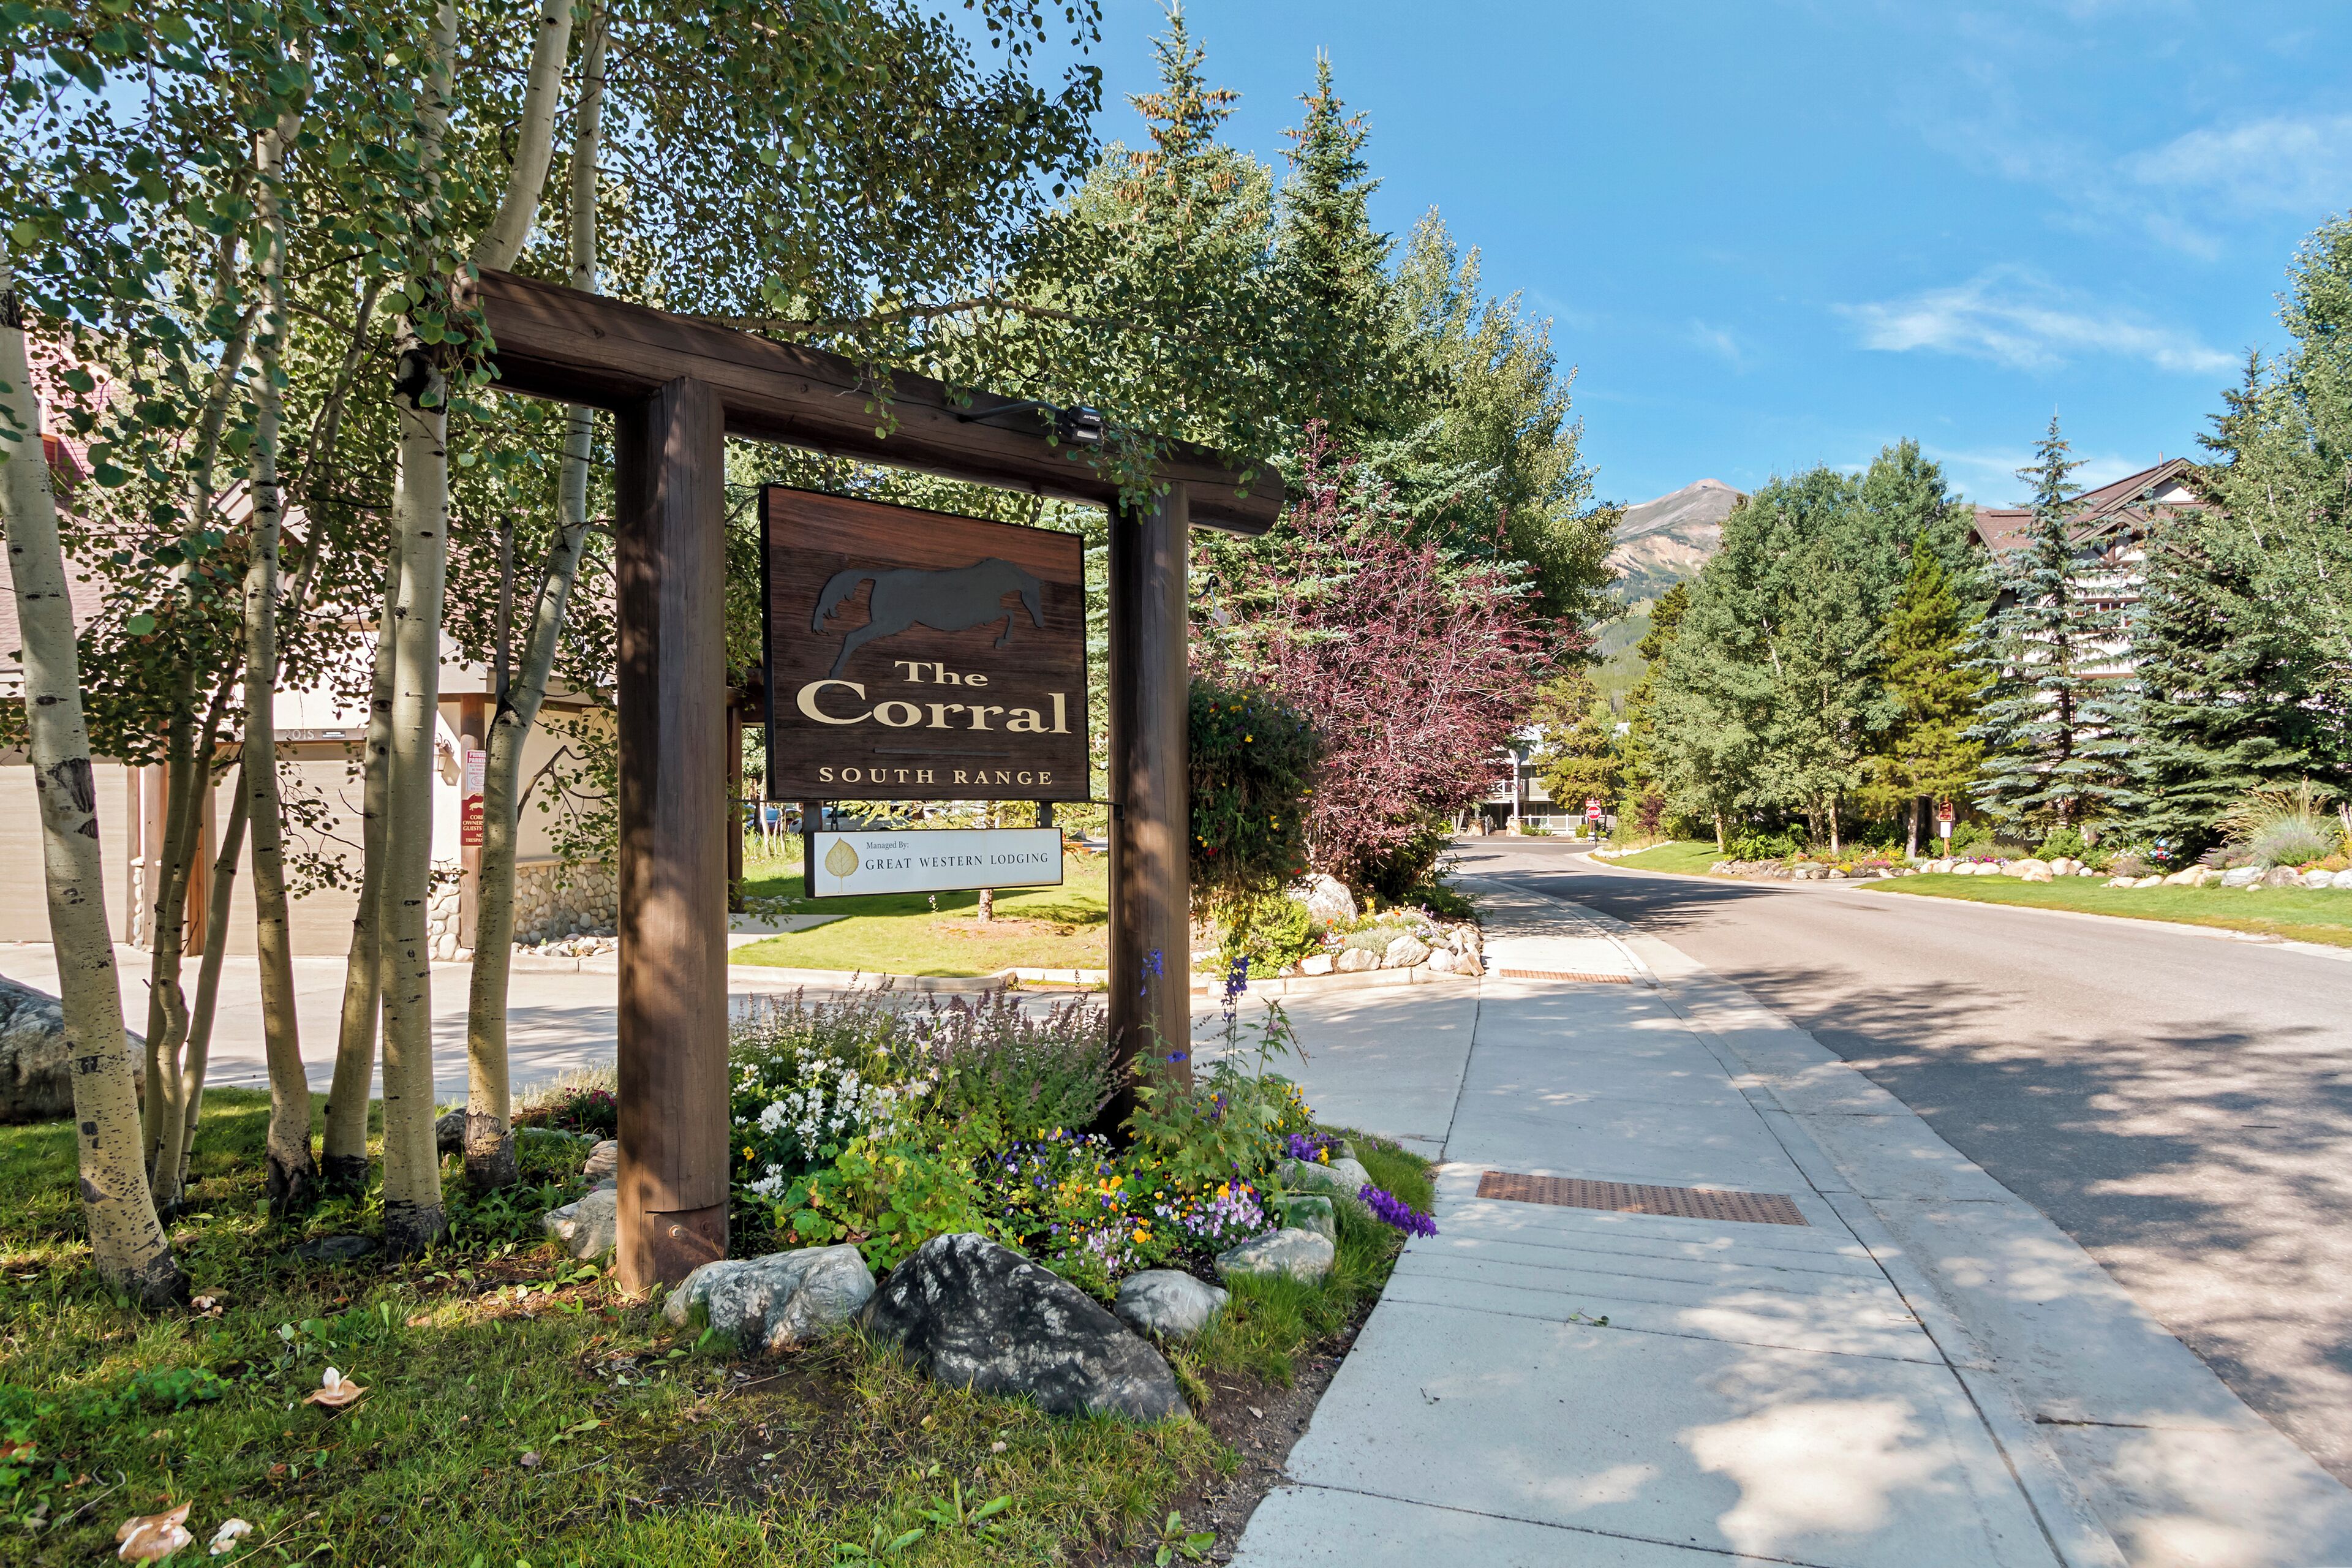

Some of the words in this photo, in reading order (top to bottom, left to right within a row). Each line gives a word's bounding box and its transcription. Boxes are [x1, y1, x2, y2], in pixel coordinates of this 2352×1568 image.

[894, 660, 989, 687] The
[796, 679, 1072, 734] Corral
[818, 767, 935, 784] SOUTH
[952, 770, 1054, 785] RANGE
[866, 841, 897, 850] Managed
[898, 841, 910, 850] By:
[865, 858, 912, 870] GREAT
[919, 855, 983, 868] WESTERN
[990, 853, 1049, 865] LODGING
